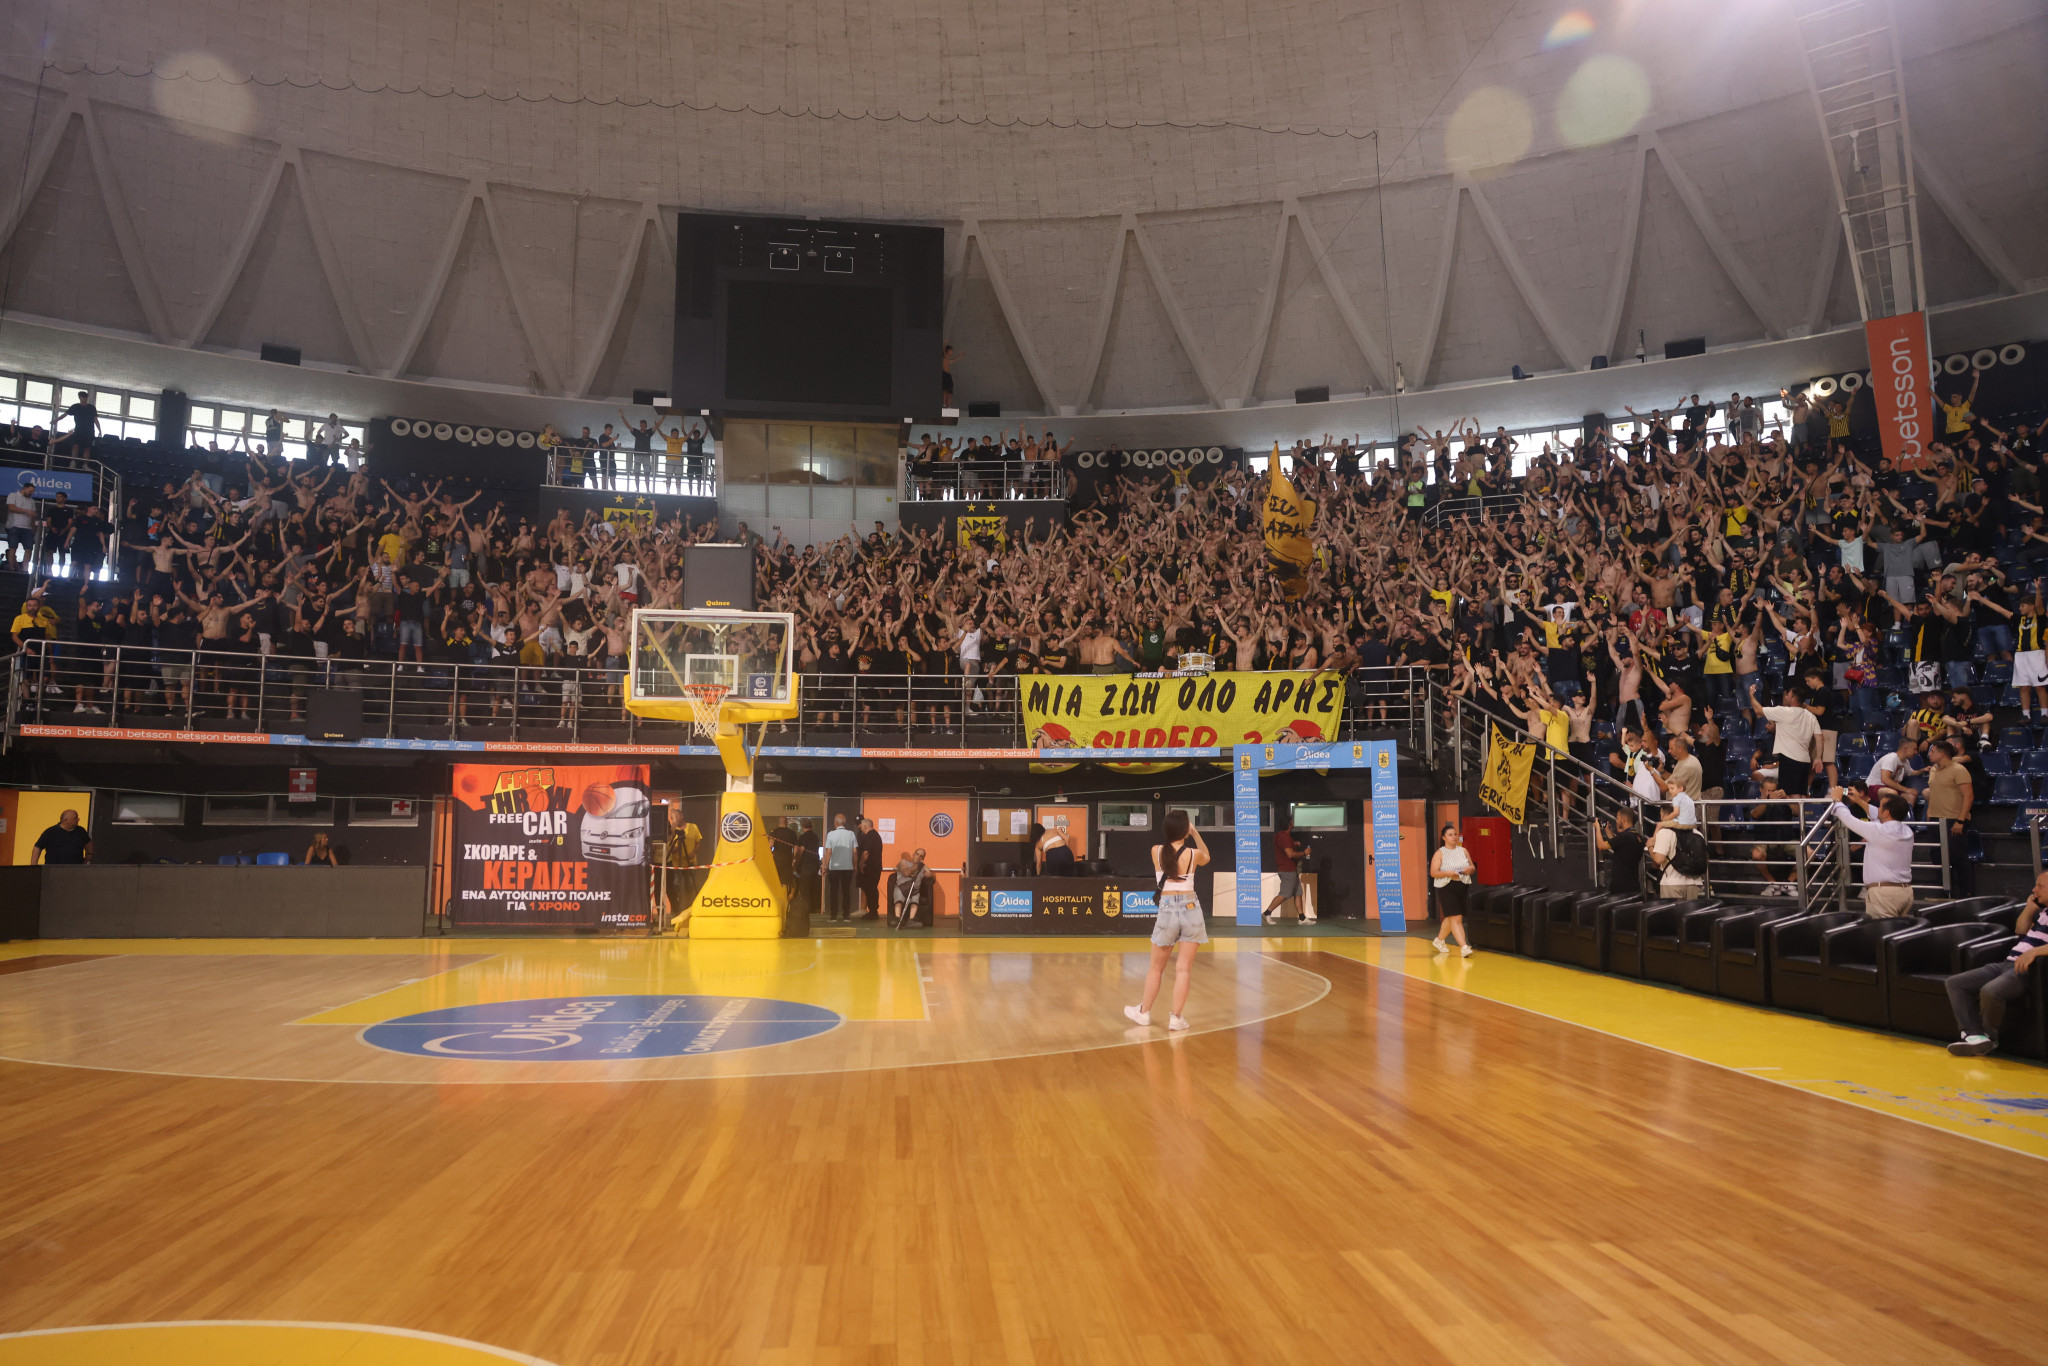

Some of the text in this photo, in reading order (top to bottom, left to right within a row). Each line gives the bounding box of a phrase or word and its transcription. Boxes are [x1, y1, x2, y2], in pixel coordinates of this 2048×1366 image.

[1889, 336, 1922, 461] betsson
[17, 471, 72, 490] Midea
[1028, 678, 1340, 718] ΜΙΑ ΖΩΗ ΟΛΟ ΑΡΗΣ
[24, 725, 265, 742] betsson betsson betsson betsson betsson
[1296, 746, 1330, 760] Midea
[500, 768, 554, 789] FREE
[490, 810, 567, 836] FREE CAR
[464, 844, 538, 861] ΣΚΟΡΑΡΕ &
[483, 860, 588, 890] ΚΕΡΔΙΣΕ
[462, 890, 611, 900] ΕΝΑ ΑΥΤΟΚΙΝΗΤΟ ΠΟΛΗΣ
[701, 895, 771, 909] betsson
[994, 892, 1030, 907] Midea
[1126, 893, 1156, 908] Mide
[506, 902, 580, 912] ΓΙΑ 1 ΧΡΟΝΟ
[601, 912, 647, 922] instacar
[422, 1001, 617, 1055] Midea
